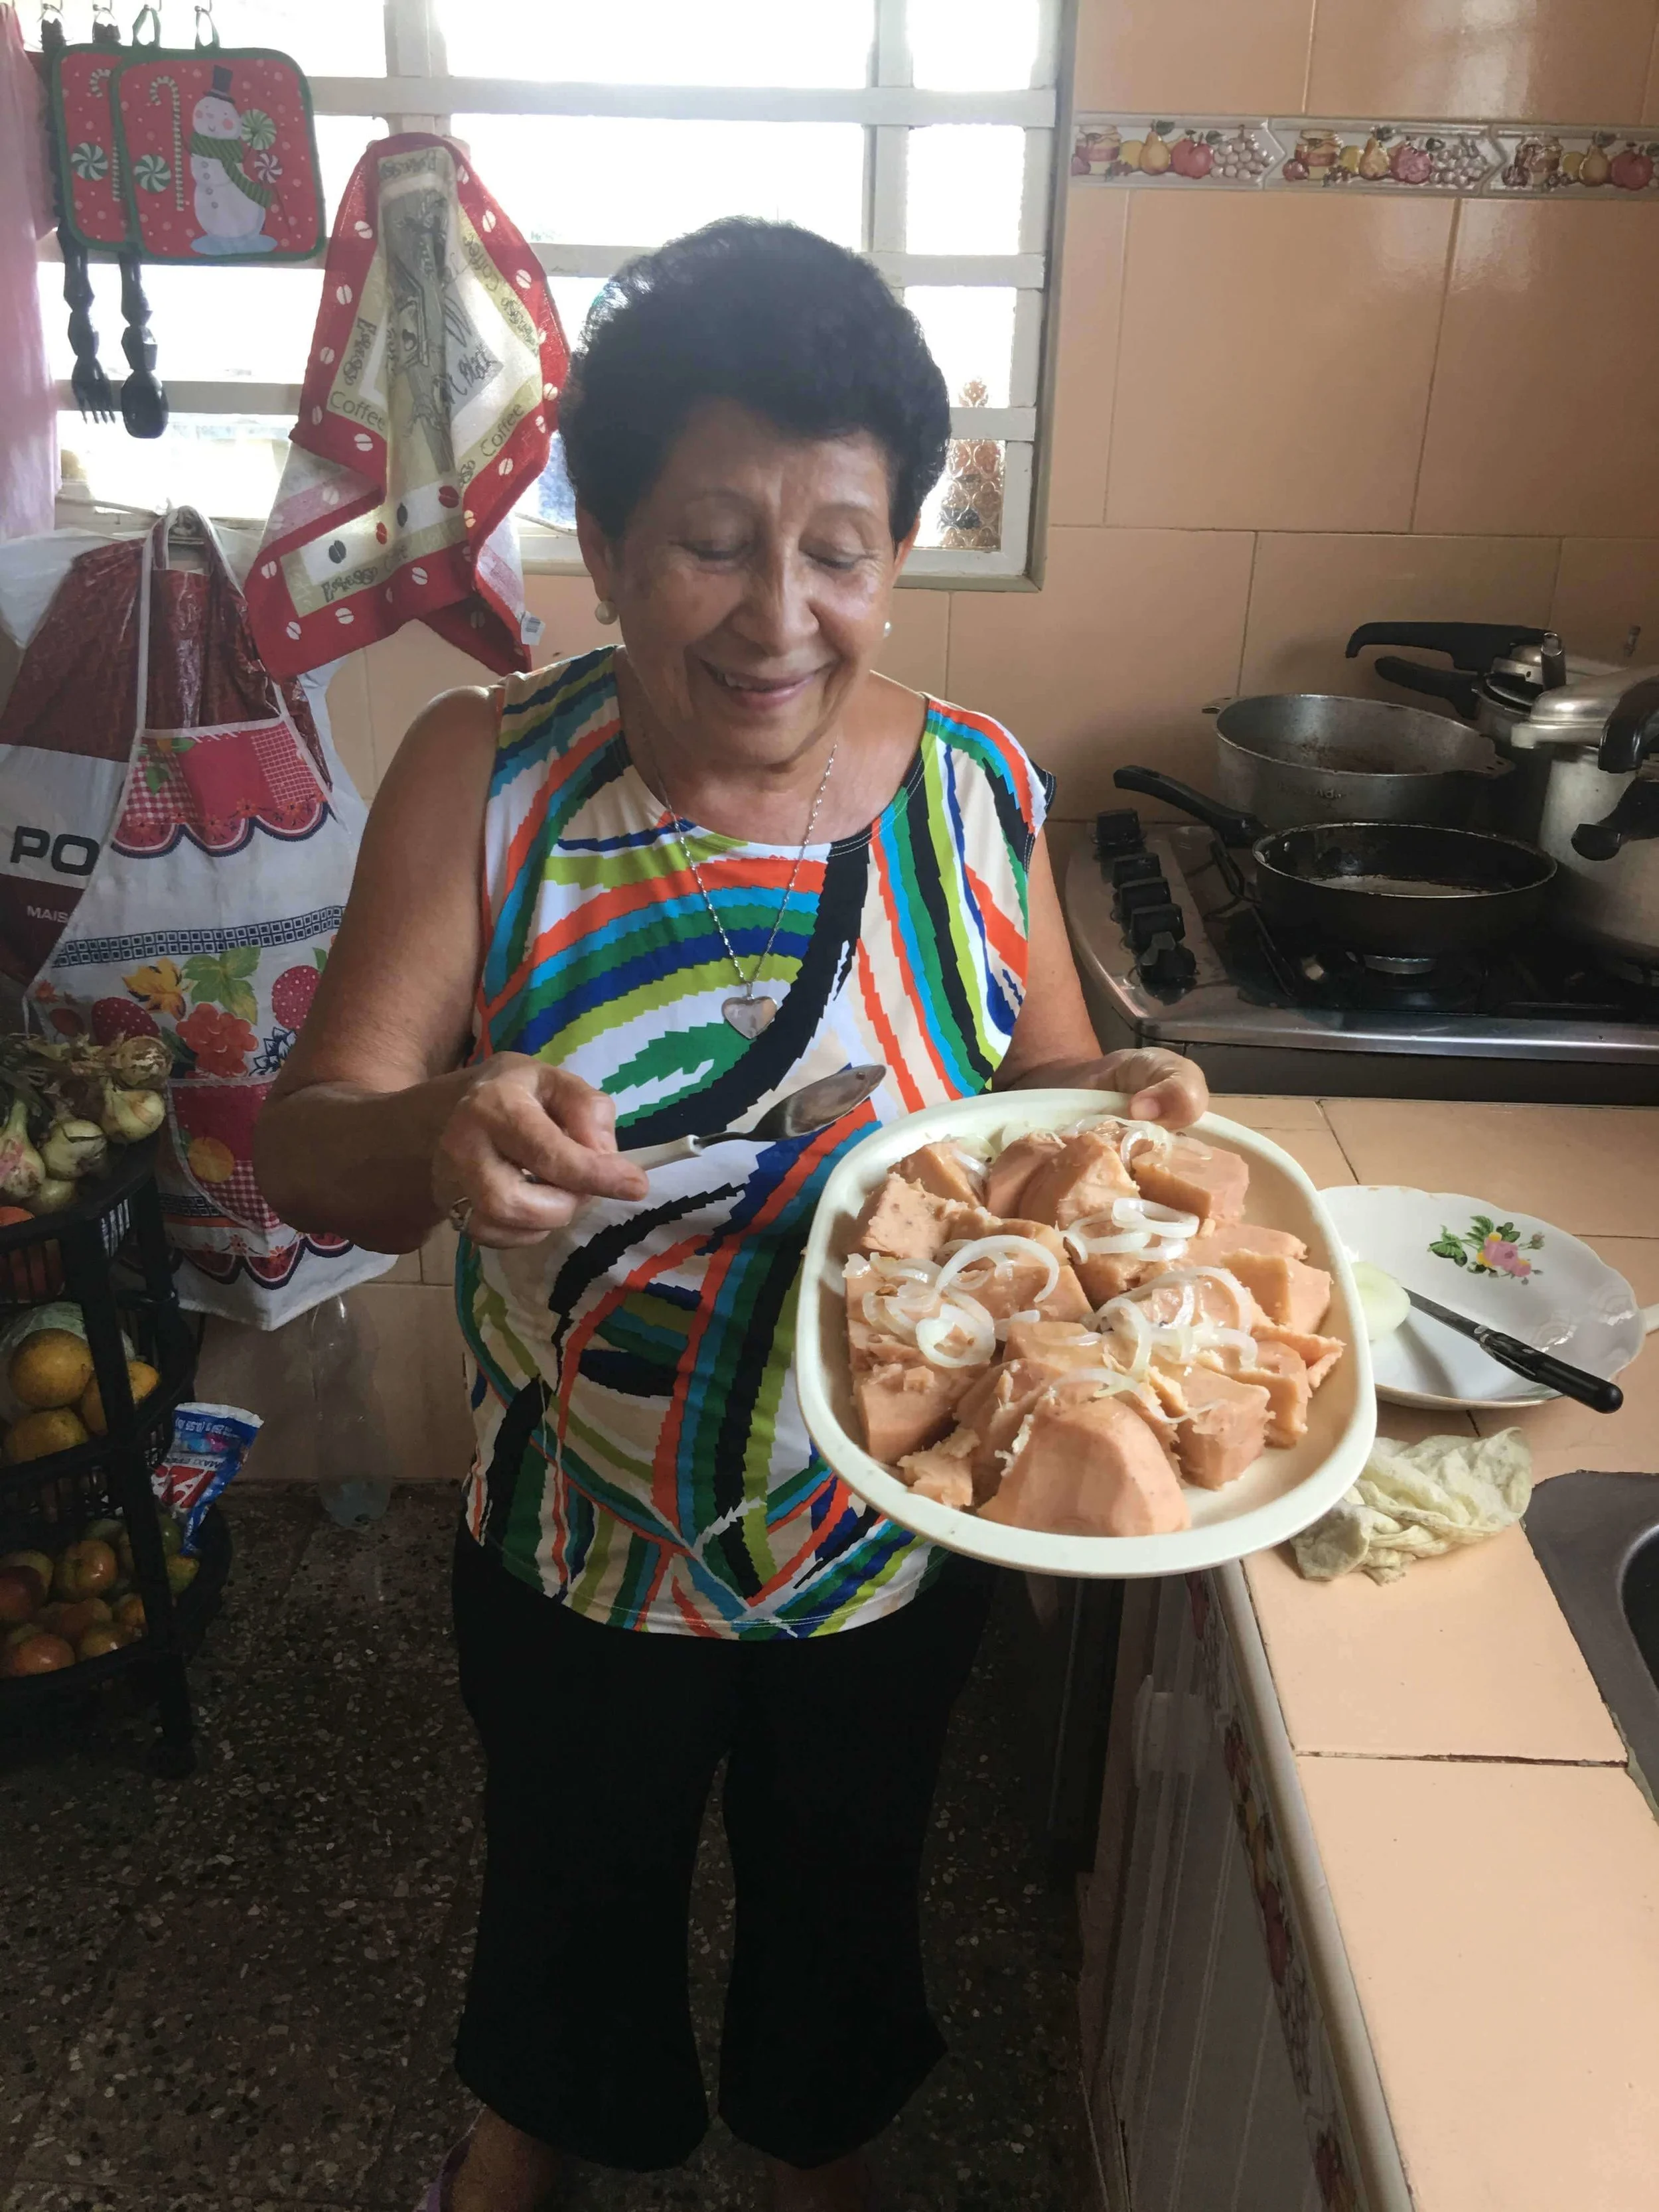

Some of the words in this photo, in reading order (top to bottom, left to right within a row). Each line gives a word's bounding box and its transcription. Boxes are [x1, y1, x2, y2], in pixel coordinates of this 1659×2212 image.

[330, 390, 387, 431] Coffee
[480, 403, 524, 457] Coffee
[11, 826, 100, 875] PO
